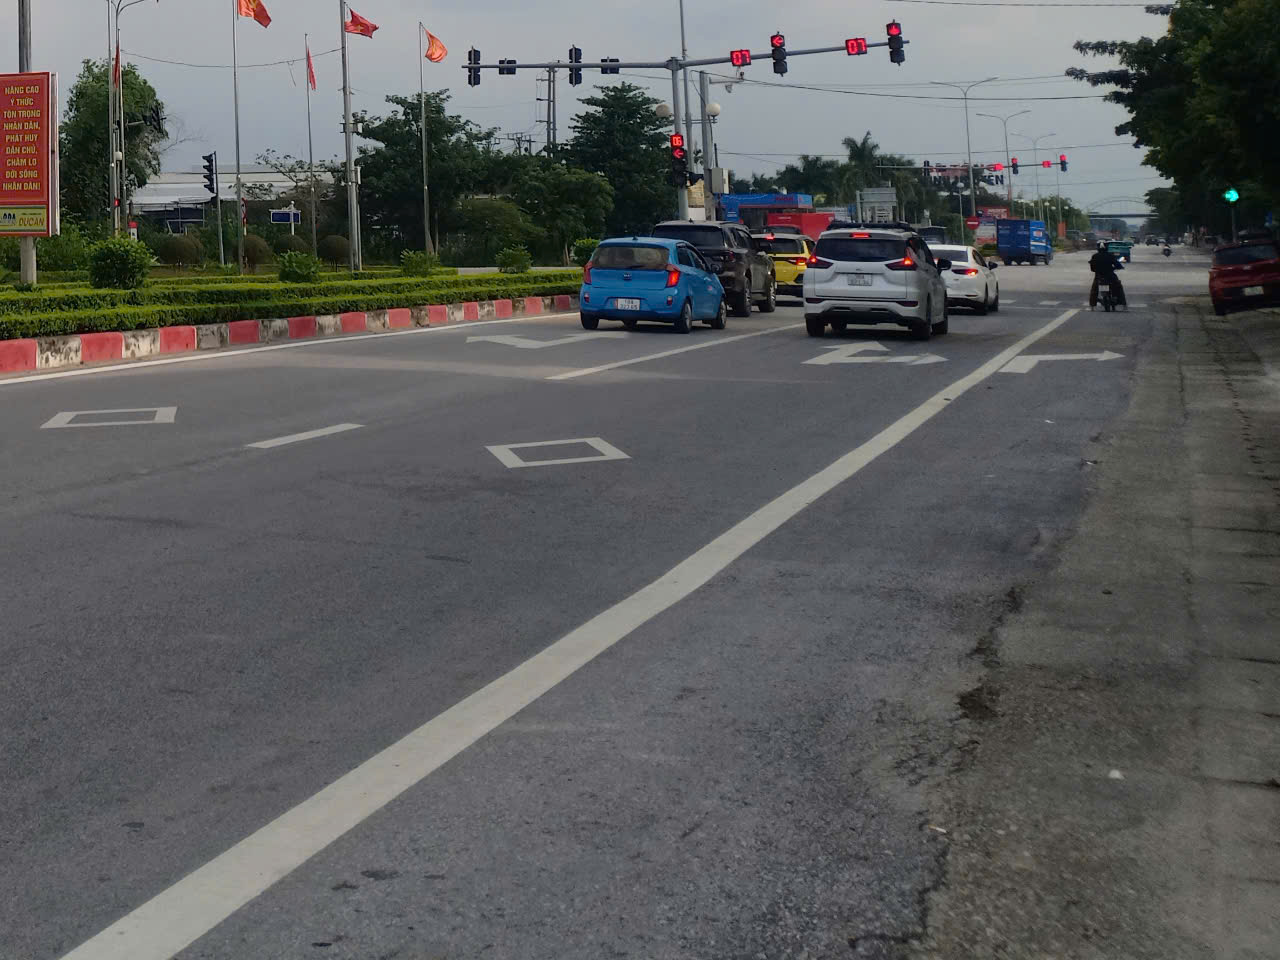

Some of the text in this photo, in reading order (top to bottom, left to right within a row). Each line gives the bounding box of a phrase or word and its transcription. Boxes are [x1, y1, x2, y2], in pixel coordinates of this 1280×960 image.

[848, 39, 866, 54] 07
[733, 51, 750, 66] 07
[4, 85, 39, 95] NÂNG CAO
[18, 109, 41, 119] TRỌNG
[3, 121, 23, 131] NHÂN
[24, 134, 38, 142] HUY
[28, 158, 37, 166] LO
[2, 181, 22, 190] NHÂN
